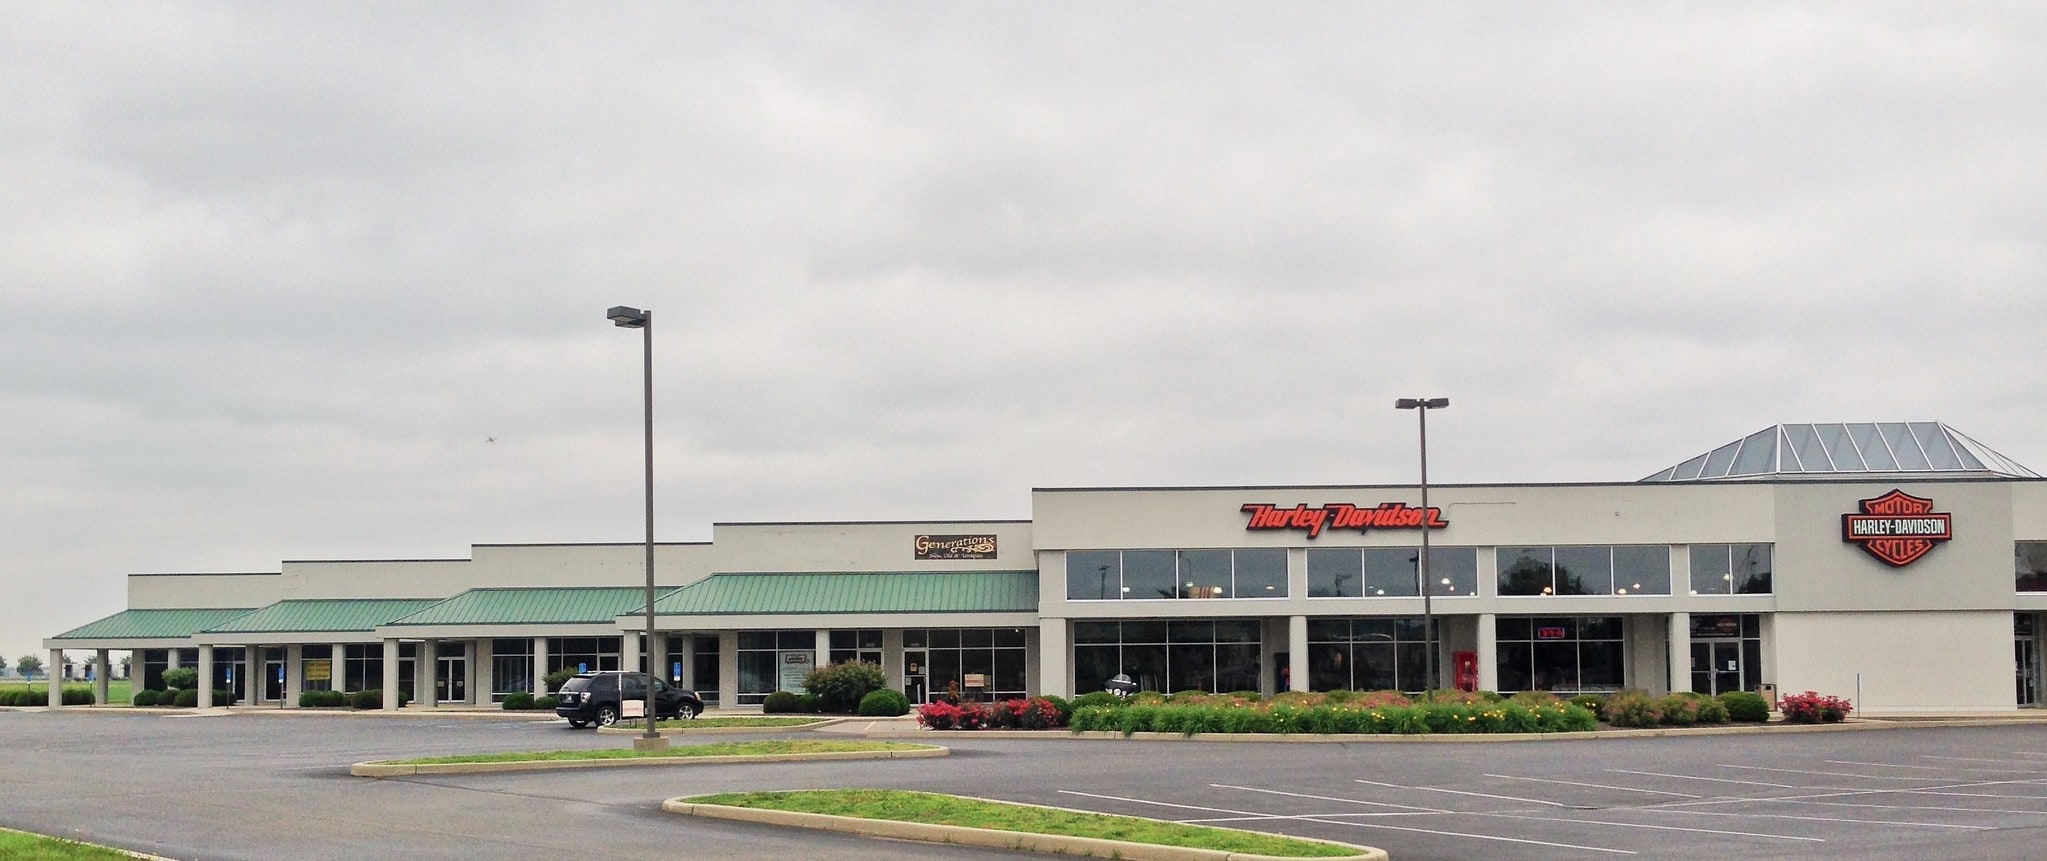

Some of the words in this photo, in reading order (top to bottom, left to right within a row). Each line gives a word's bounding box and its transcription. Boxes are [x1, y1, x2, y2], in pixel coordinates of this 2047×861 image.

[1874, 497, 1923, 514] MOTOR
[1241, 503, 1449, 539] Harley-Davidson
[1853, 519, 1945, 535] HARLEY-DAVIDSON
[915, 535, 995, 555] Generations
[1875, 539, 1924, 559] CYCLES
